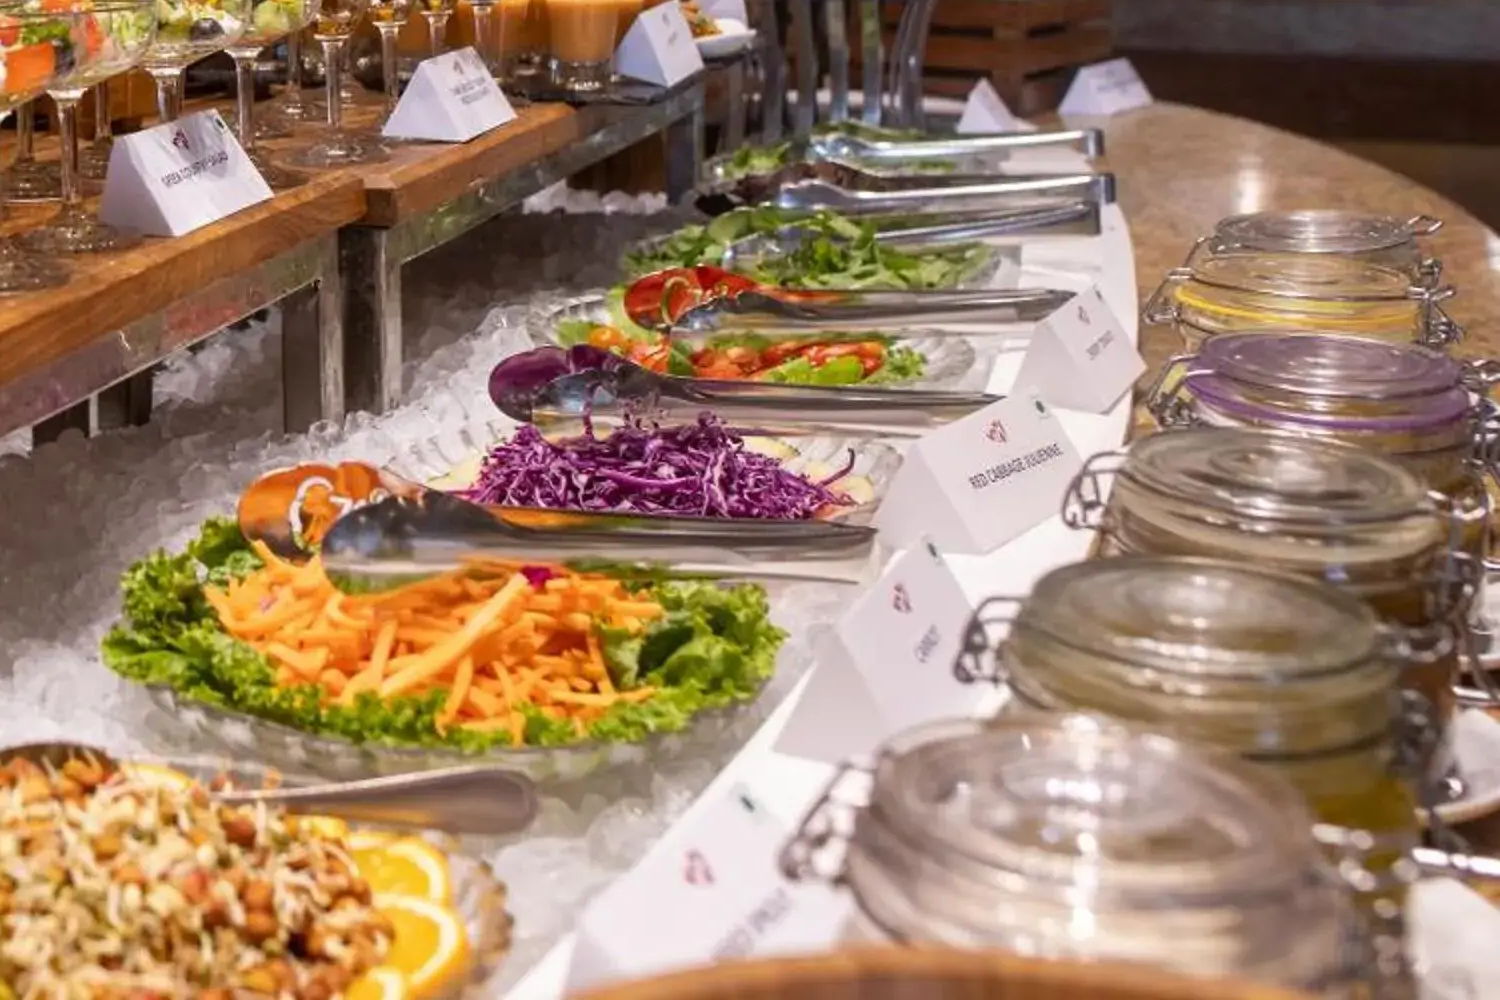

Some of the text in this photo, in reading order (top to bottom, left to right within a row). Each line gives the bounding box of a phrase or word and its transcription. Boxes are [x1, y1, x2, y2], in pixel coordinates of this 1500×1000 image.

[969, 442, 1064, 489] RED CABBAGE JULIENNE
